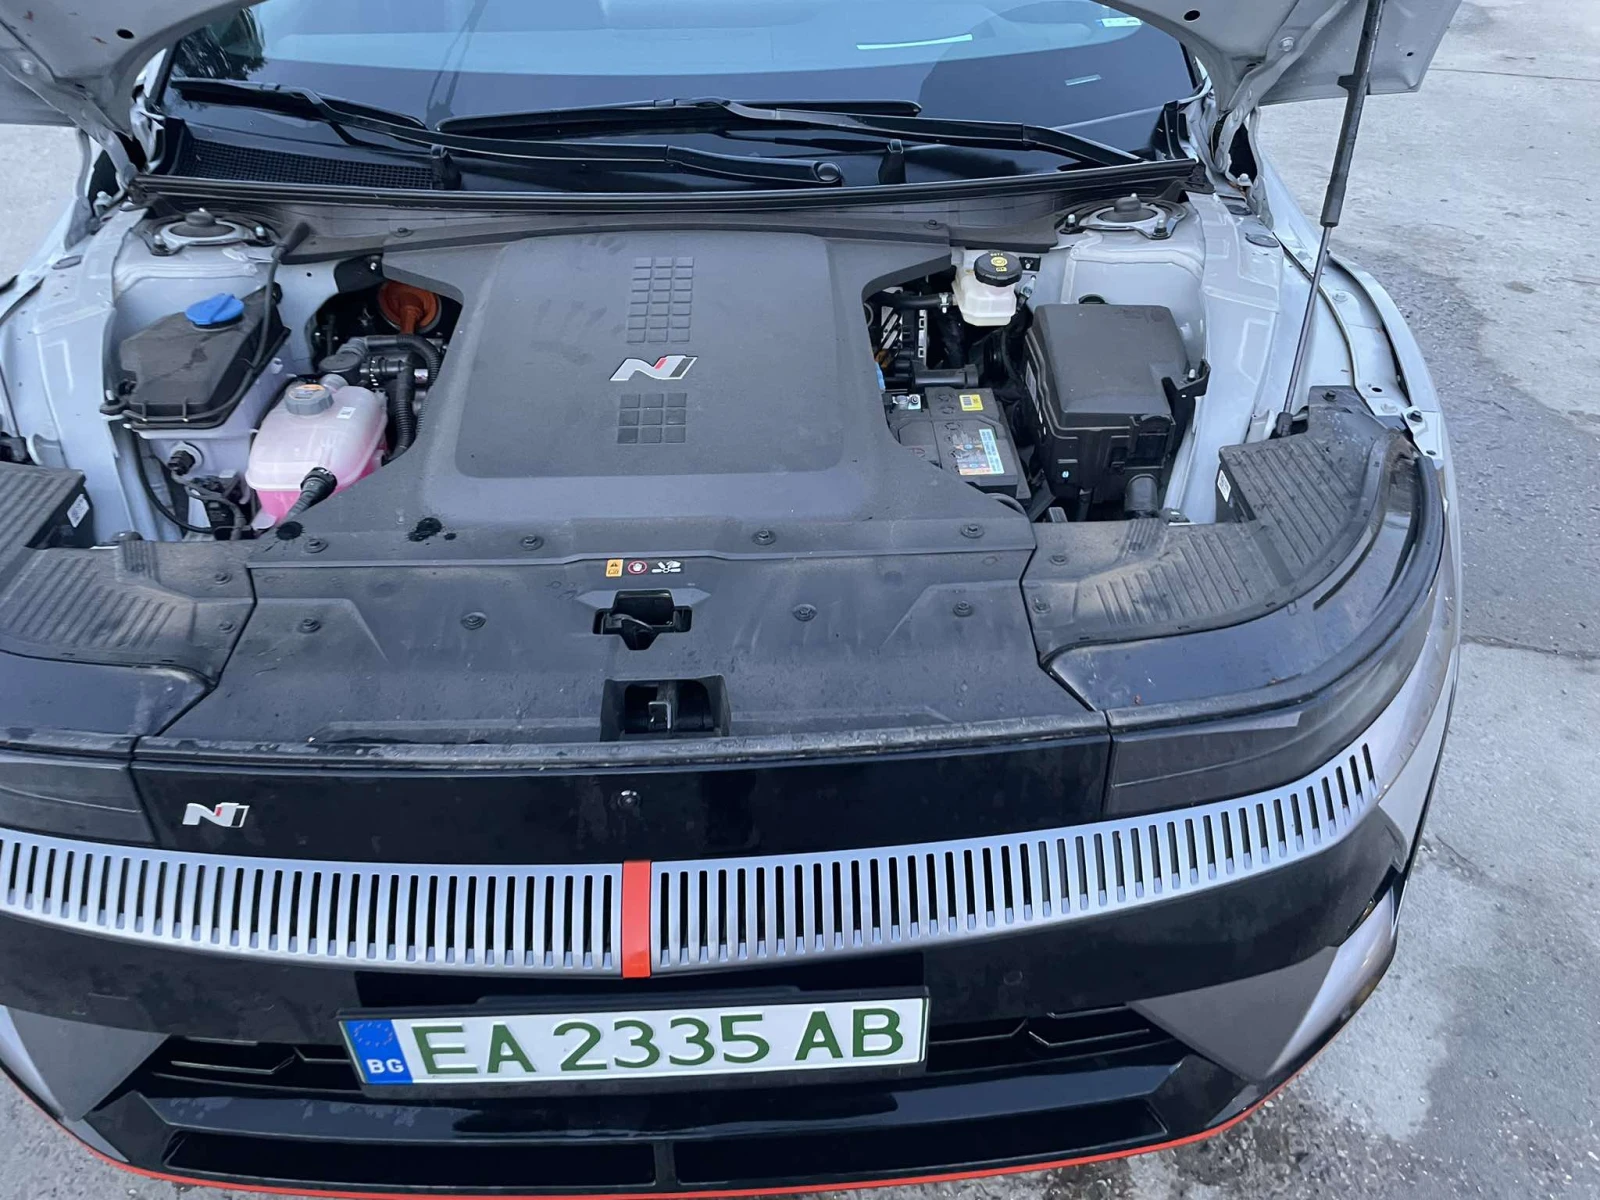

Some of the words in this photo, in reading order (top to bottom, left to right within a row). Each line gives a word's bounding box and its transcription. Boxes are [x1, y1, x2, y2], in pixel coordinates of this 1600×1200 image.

[411, 1024, 536, 1075] EA
[554, 1013, 771, 1072] 2335
[795, 1007, 905, 1061] AB
[366, 1058, 404, 1074] BG
